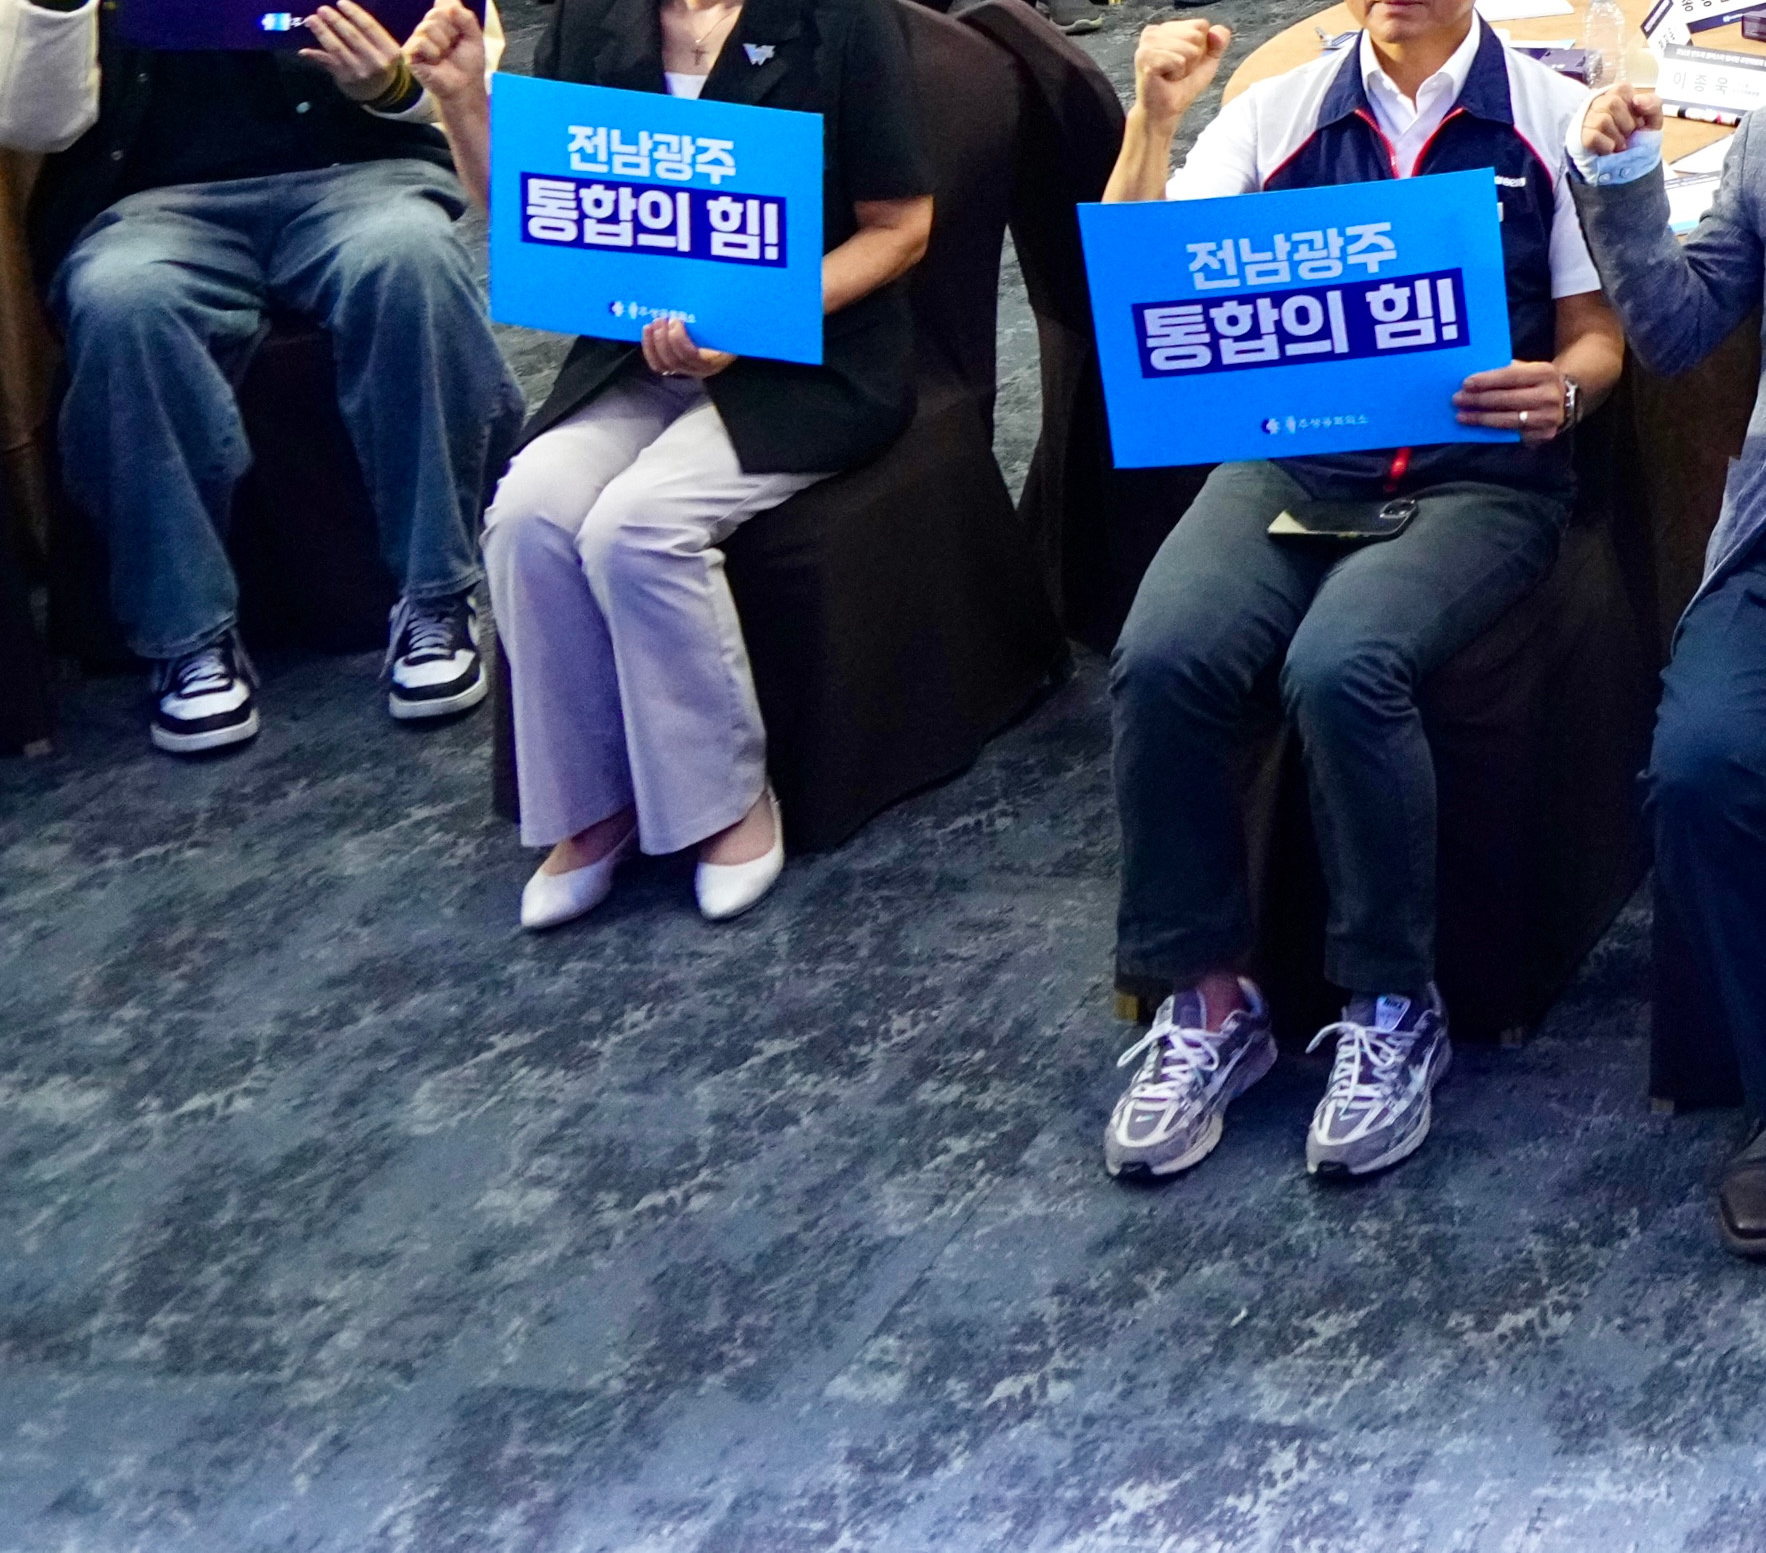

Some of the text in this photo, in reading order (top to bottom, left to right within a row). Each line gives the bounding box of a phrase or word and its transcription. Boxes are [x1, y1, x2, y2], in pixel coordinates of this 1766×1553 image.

[568, 126, 736, 184] 전남광주
[527, 178, 778, 259] 통합의 힘!
[1187, 222, 1397, 289] 전남광주
[1144, 278, 1457, 370] 통합의 힘!
[1287, 414, 1369, 434] 주상공회의소
